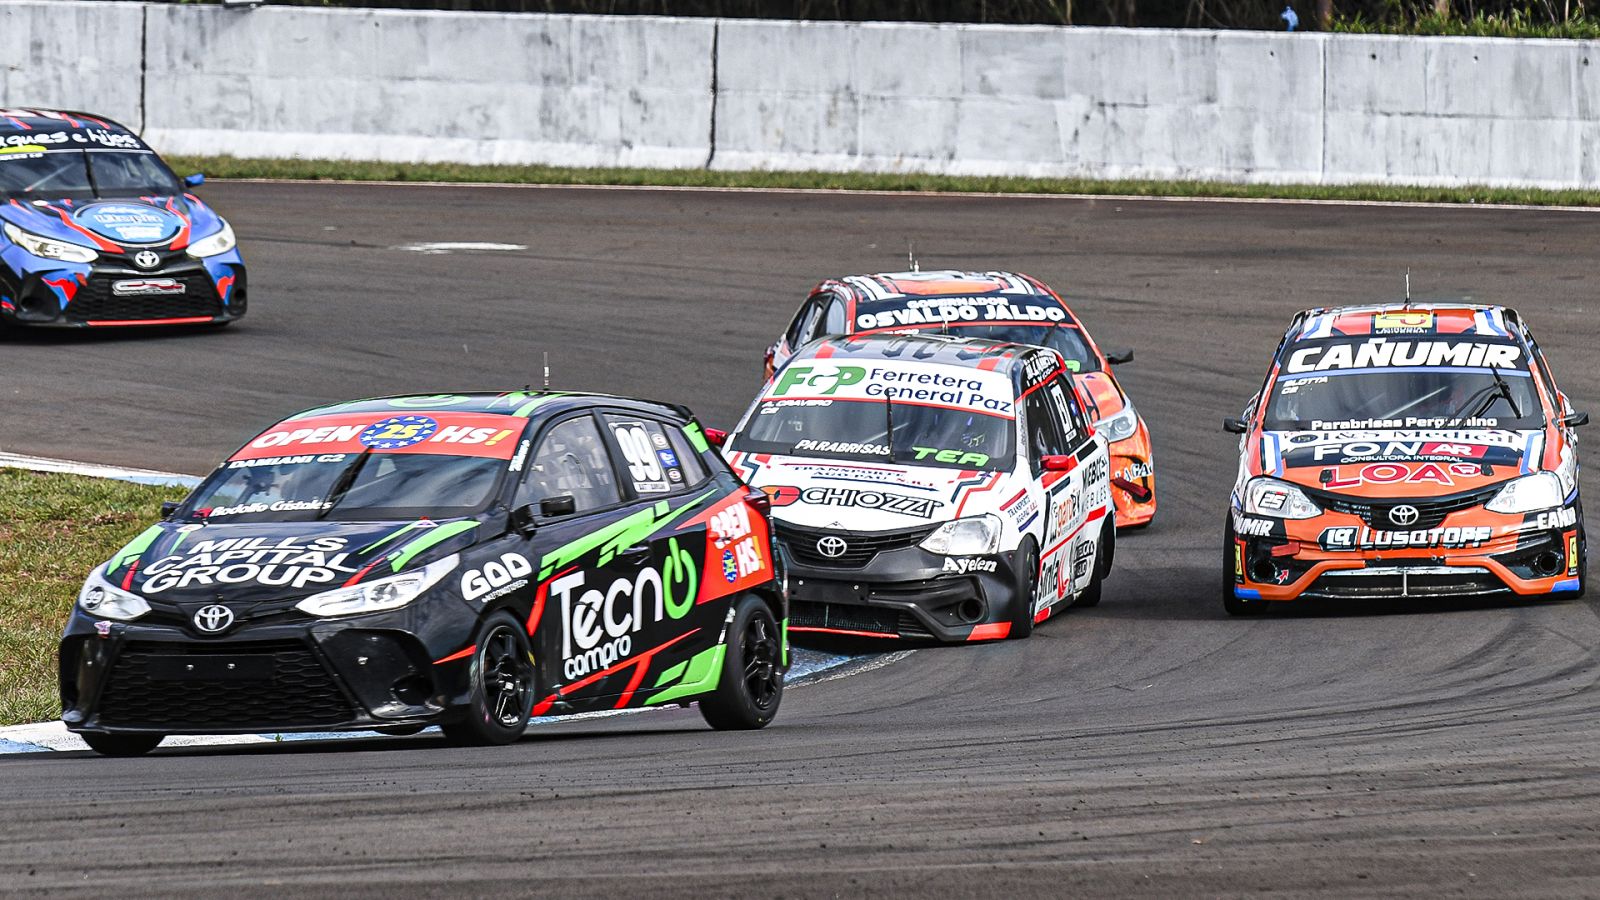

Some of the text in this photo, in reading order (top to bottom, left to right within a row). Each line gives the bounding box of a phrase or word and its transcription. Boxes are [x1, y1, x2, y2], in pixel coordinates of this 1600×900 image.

[907, 297, 1010, 309] GOBERNADOR
[857, 303, 1065, 329] OSVALDO JALDO
[870, 367, 983, 391] Ferretera
[865, 382, 1012, 413] General Paz
[1311, 417, 1403, 431] Parabrisas
[251, 424, 514, 449] OPEN 25 HS!
[615, 427, 661, 482] 99
[795, 440, 890, 456] PARABRISAS
[911, 446, 990, 467] TEA
[1340, 454, 1463, 464] CONSULTORA INTEGRAL
[228, 455, 316, 469] DAMIANI
[1324, 462, 1455, 490] LOA
[208, 502, 269, 518] Rodolfo
[188, 537, 348, 555] MILLS
[142, 549, 358, 576] CAPITAL
[941, 556, 998, 575] Ayelen
[141, 564, 336, 594] GROUP
[563, 634, 633, 681] compro
